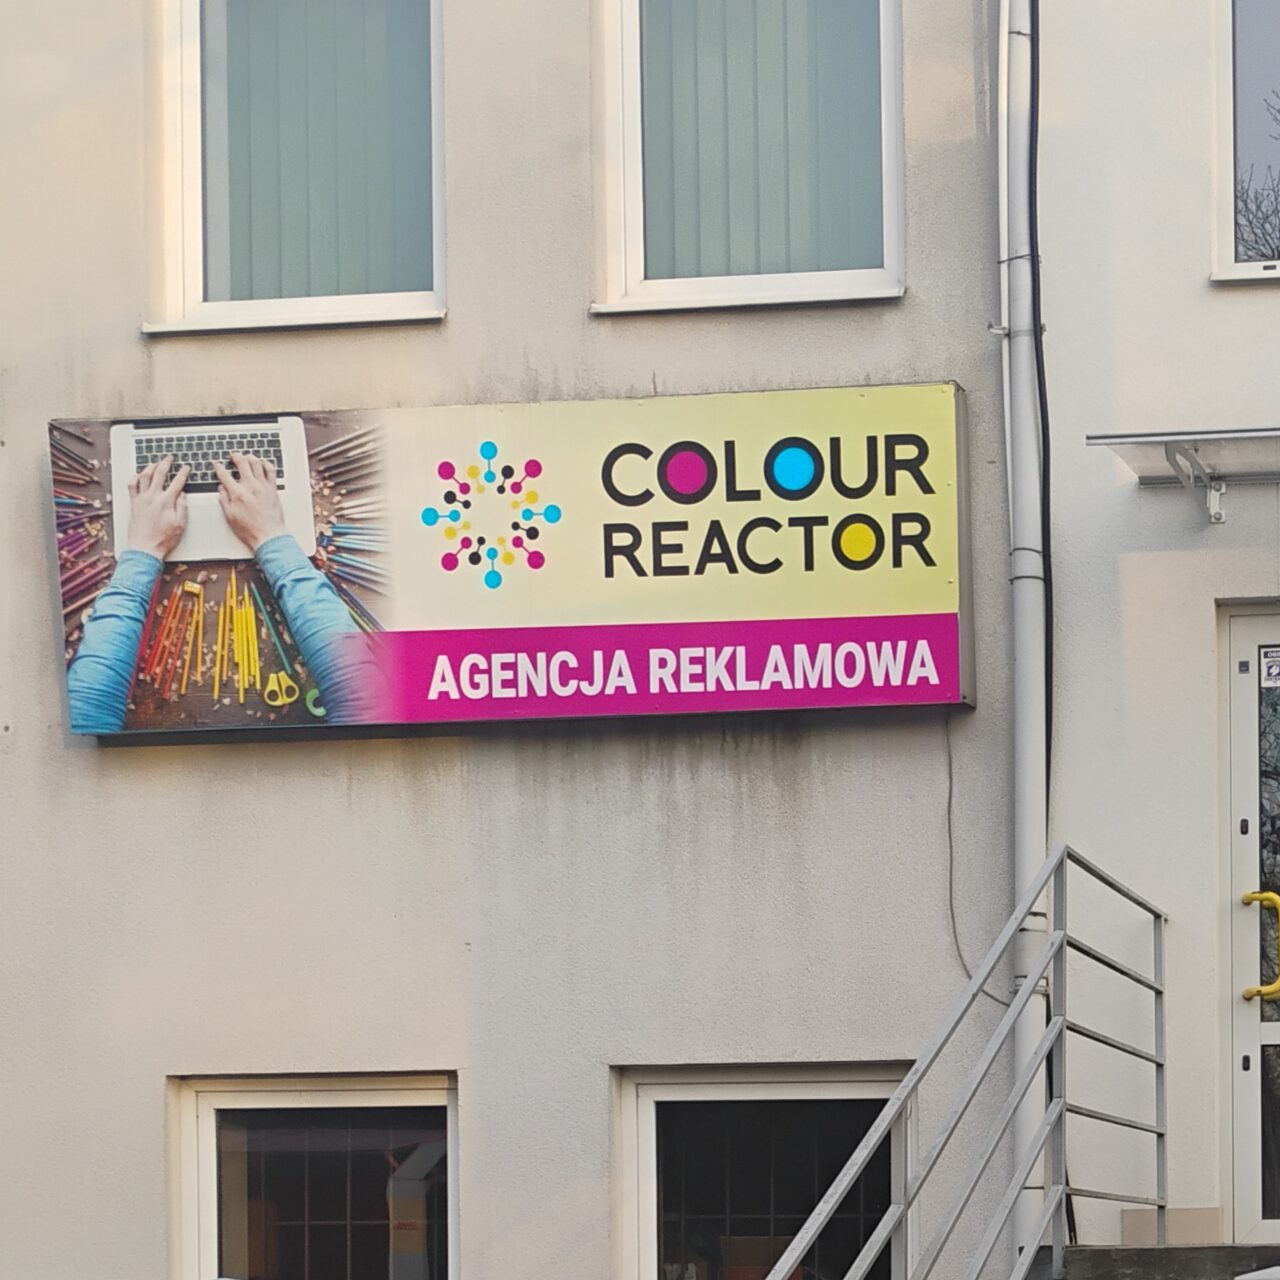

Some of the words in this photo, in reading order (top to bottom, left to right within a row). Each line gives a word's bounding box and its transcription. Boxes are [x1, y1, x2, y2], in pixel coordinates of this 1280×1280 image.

[601, 433, 936, 507] COLOUR
[603, 512, 938, 578] REACTOR
[427, 650, 637, 701] AGENCJA
[649, 640, 940, 694] REKLAMOWA
